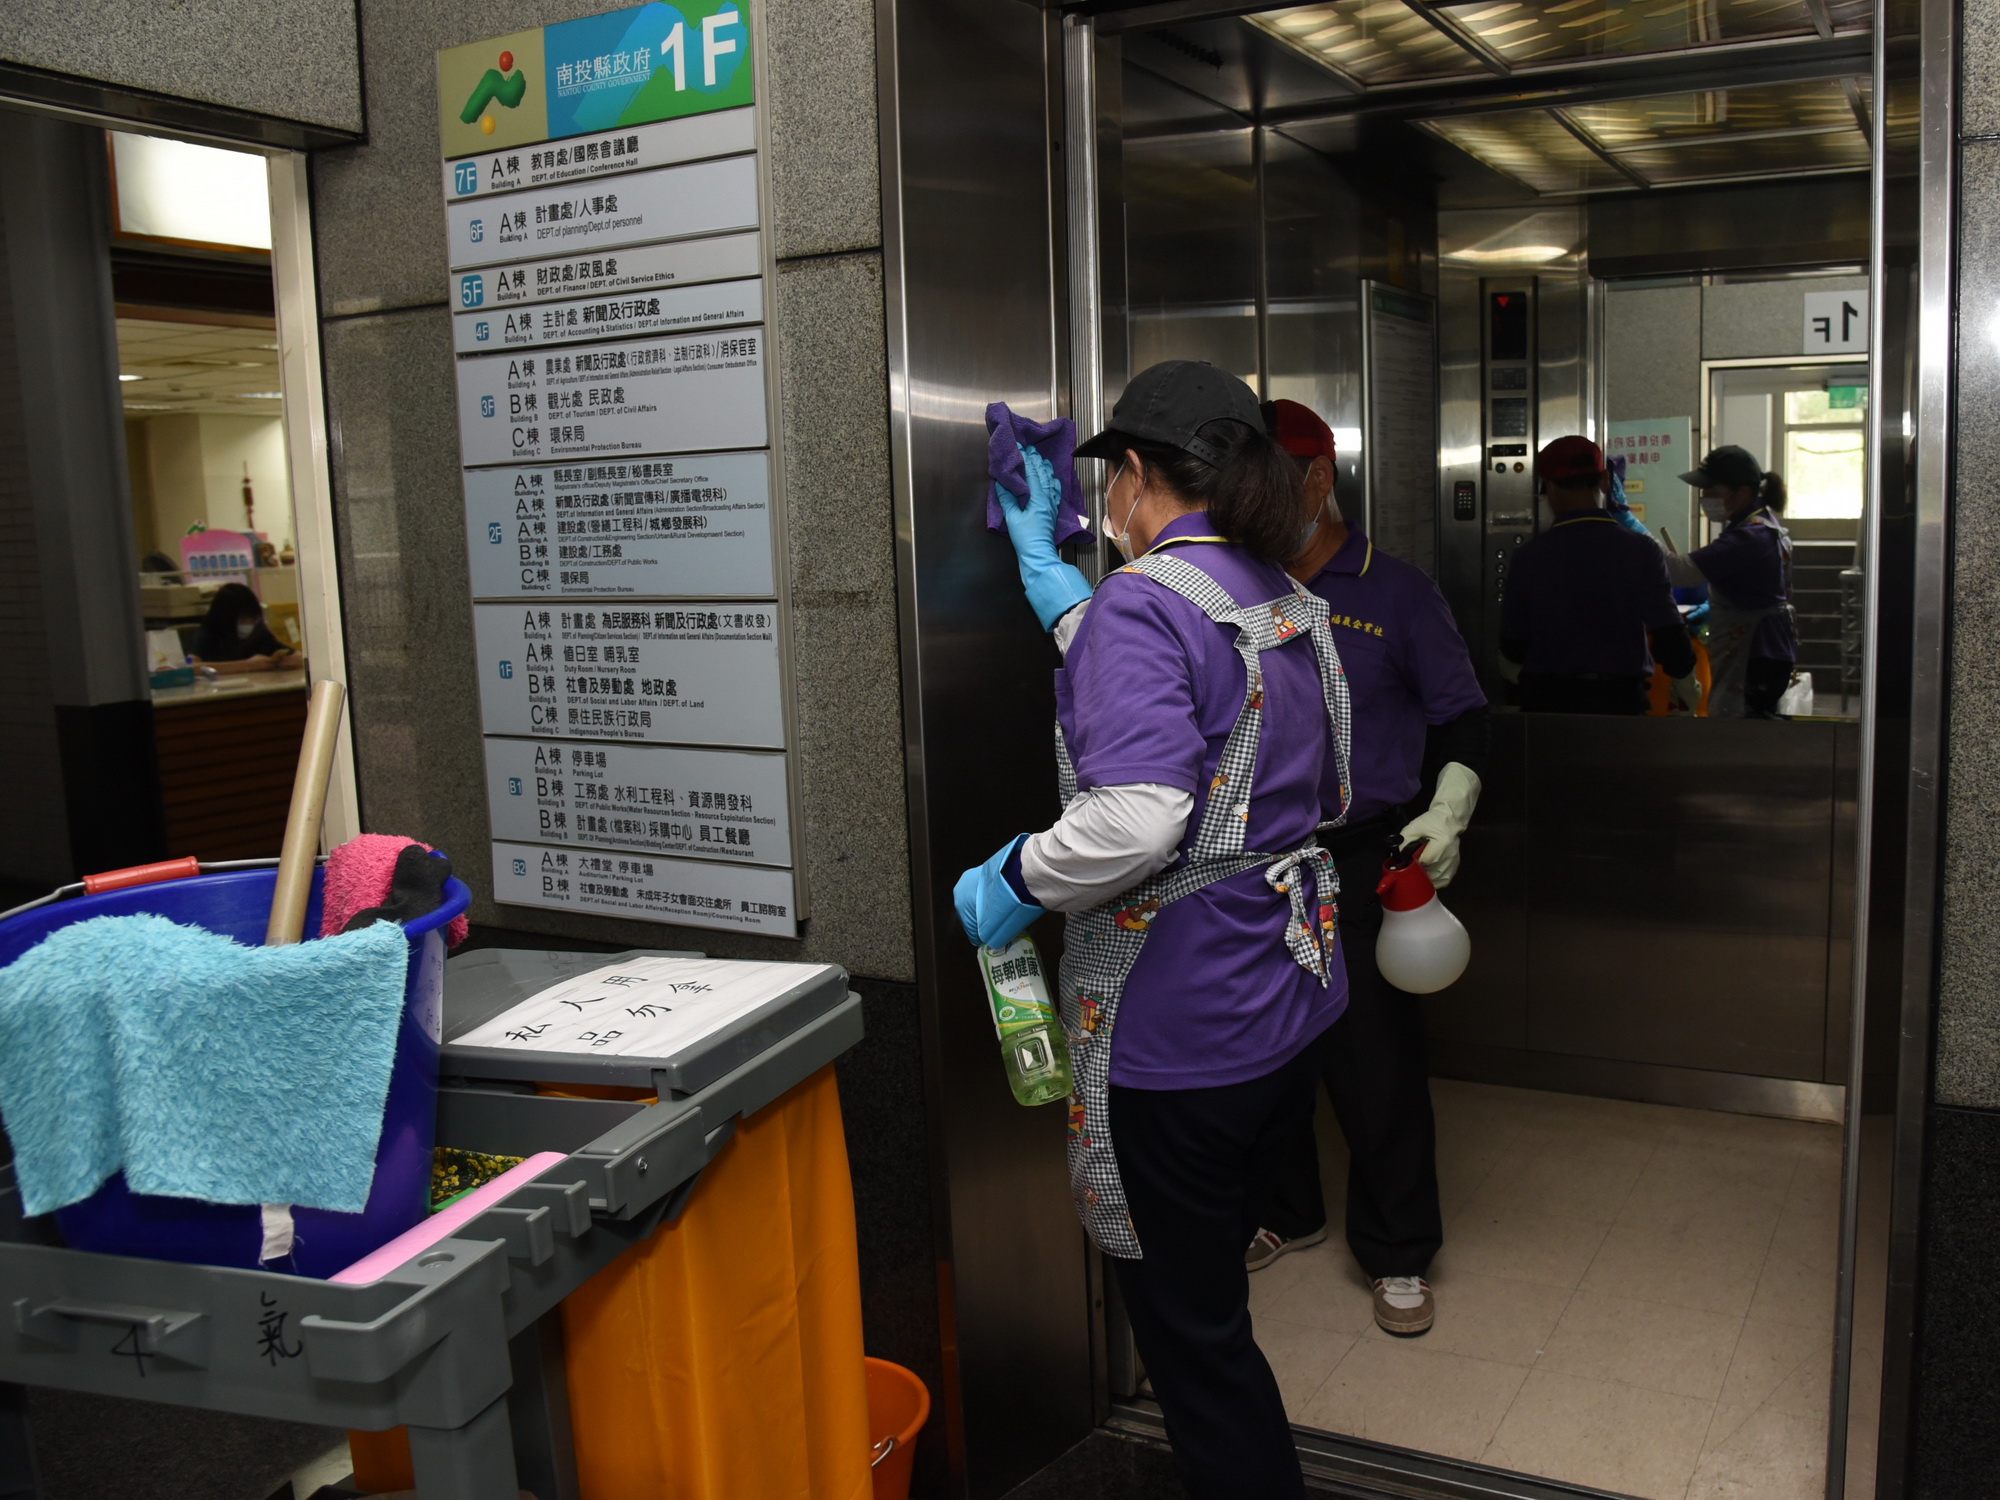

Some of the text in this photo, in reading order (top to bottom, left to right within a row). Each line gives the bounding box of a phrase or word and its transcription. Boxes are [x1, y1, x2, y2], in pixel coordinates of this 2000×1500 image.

[661, 10, 739, 91] 1F
[556, 47, 651, 87] 南投縣政府
[558, 72, 651, 98] NANTOU COUNTY GOVERNMENT
[531, 135, 639, 171] 教育處/國際會議廳
[456, 167, 476, 191] 7F
[491, 180, 515, 190] Building
[532, 173, 549, 184] DEPT.
[550, 171, 556, 179] of
[557, 166, 586, 179] Education
[590, 160, 625, 173] Conference
[625, 158, 639, 168] Hall
[535, 195, 618, 223] 計畫處/人事處
[471, 223, 483, 241] 6F
[500, 233, 523, 243] Building
[611, 214, 643, 230] personnel
[537, 258, 617, 285] 財政處/政風處
[461, 280, 482, 304] 5F
[498, 291, 521, 301] Building
[537, 286, 555, 296] DEPT.
[556, 285, 562, 294] of
[563, 283, 586, 293] Finance
[590, 280, 608, 290] DEPT.
[609, 278, 615, 287] of
[616, 276, 630, 286] Civil
[631, 274, 654, 284] Service
[654, 271, 675, 281] Ethics
[543, 308, 578, 329] 主計處
[583, 298, 661, 323] 新聞及行政處
[476, 325, 489, 338] 4F
[505, 334, 528, 344] Building
[508, 381, 530, 389] Building
[481, 398, 494, 416] 3F
[548, 390, 583, 410] 觀光處
[589, 386, 625, 406] 民政處
[510, 415, 532, 423] Building
[549, 411, 566, 420] DEPT.
[566, 410, 572, 418] of
[573, 409, 596, 418] Tourism
[599, 407, 617, 416] DEPT.
[617, 407, 623, 415] of
[624, 405, 637, 414] Civil
[637, 404, 658, 413] Affairs
[550, 425, 585, 444] 環保局
[512, 448, 535, 456] Building
[551, 444, 590, 454] Environmental
[591, 442, 620, 451] Protection
[621, 441, 642, 450] Bureau
[490, 526, 502, 542] 2F
[560, 571, 589, 584] 環保局
[561, 612, 597, 629] 計畫處
[524, 631, 547, 640] Building
[563, 645, 598, 662] 值日室
[604, 645, 640, 663] 哺乳室
[500, 664, 513, 675] 1F
[526, 664, 550, 673] Building
[564, 665, 577, 674] Duty
[578, 665, 594, 673] Room
[597, 666, 619, 675] Nursery
[620, 666, 637, 674] Room
[566, 676, 635, 695] 社會及勞動處
[641, 678, 678, 697] 地政處
[529, 695, 551, 704] Building
[568, 708, 652, 728] 原住民族行政局
[531, 726, 554, 735] Building
[569, 727, 600, 736] Indigenous
[600, 728, 624, 738] People's
[624, 729, 645, 738] Bureau
[572, 750, 607, 768] 停車場
[535, 766, 559, 776] Building
[572, 769, 594, 779] Parking
[595, 770, 604, 779] Lot
[510, 780, 521, 794] B1
[574, 782, 609, 802] 工務處
[538, 798, 560, 808] Building
[541, 830, 563, 839] Building
[700, 824, 751, 846] 員工餐廳
[513, 860, 526, 874] B2
[541, 866, 564, 875] Building
[578, 857, 612, 872] 大禮堂
[619, 860, 653, 877] 停車場
[542, 891, 564, 900] Building
[580, 881, 629, 899] 社會及勞動處
[991, 956, 1040, 986] 每朝健康
[258, 1291, 303, 1367] 氣
[111, 1323, 156, 1378] 4
